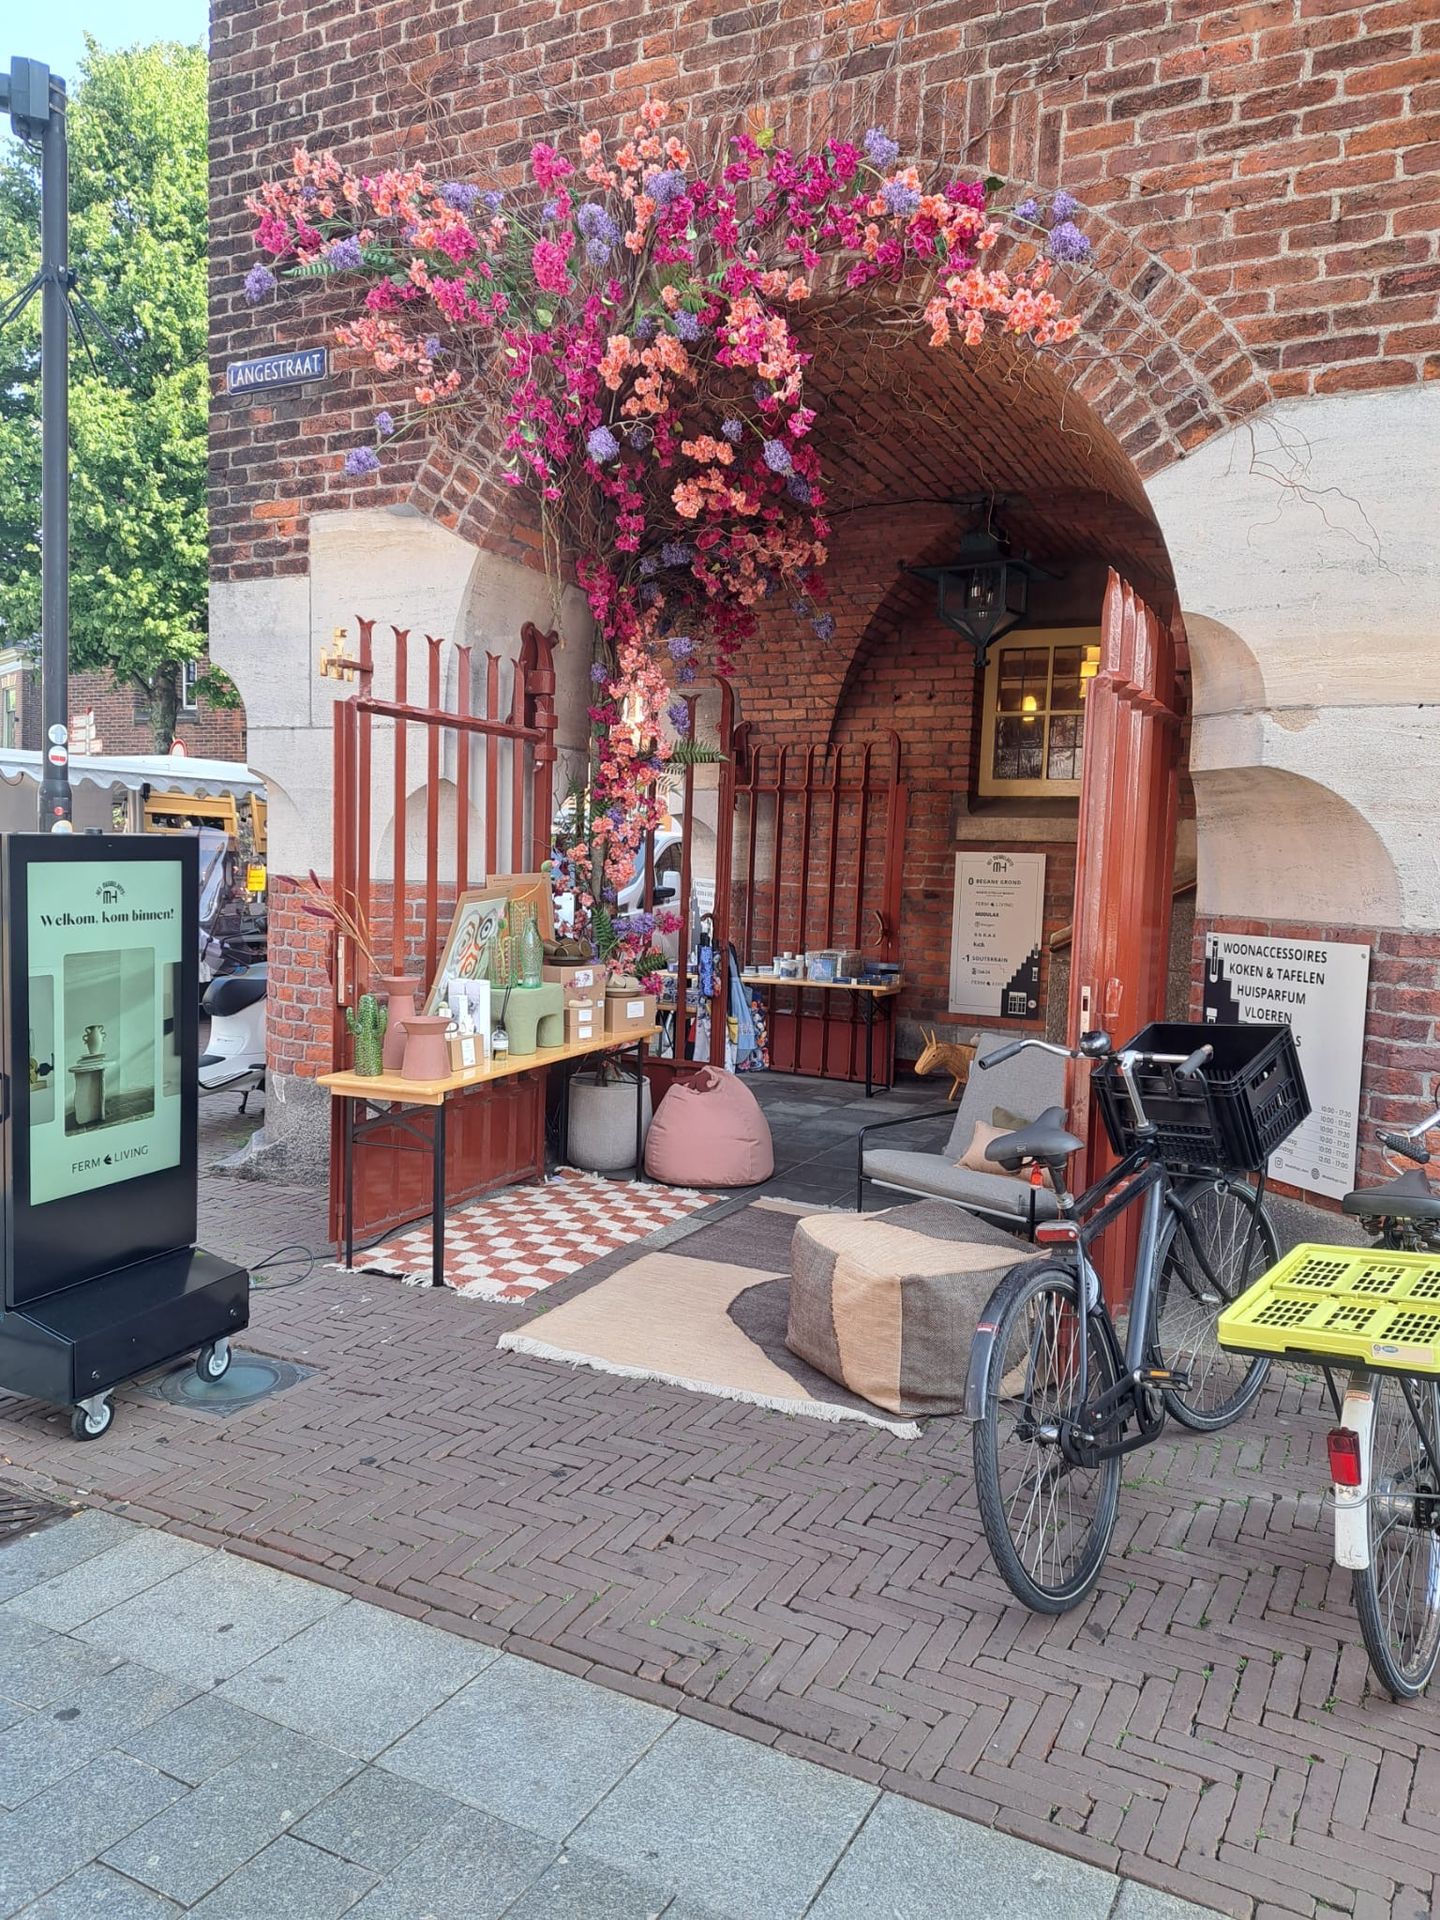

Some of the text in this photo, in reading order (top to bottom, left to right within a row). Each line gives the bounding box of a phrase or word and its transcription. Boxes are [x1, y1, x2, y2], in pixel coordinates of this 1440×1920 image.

[230, 353, 320, 387] LANGESTRAAT
[102, 910, 128, 923] kom
[132, 908, 174, 922] binnen!
[1224, 942, 1328, 964] WOONACCESSOIRES
[1229, 963, 1326, 985] KOKEN & TAFELEN
[1237, 984, 1306, 1005] HUISPARFUM
[1245, 1006, 1292, 1024] VLOEREN
[72, 1145, 148, 1174] FERM LIVING
